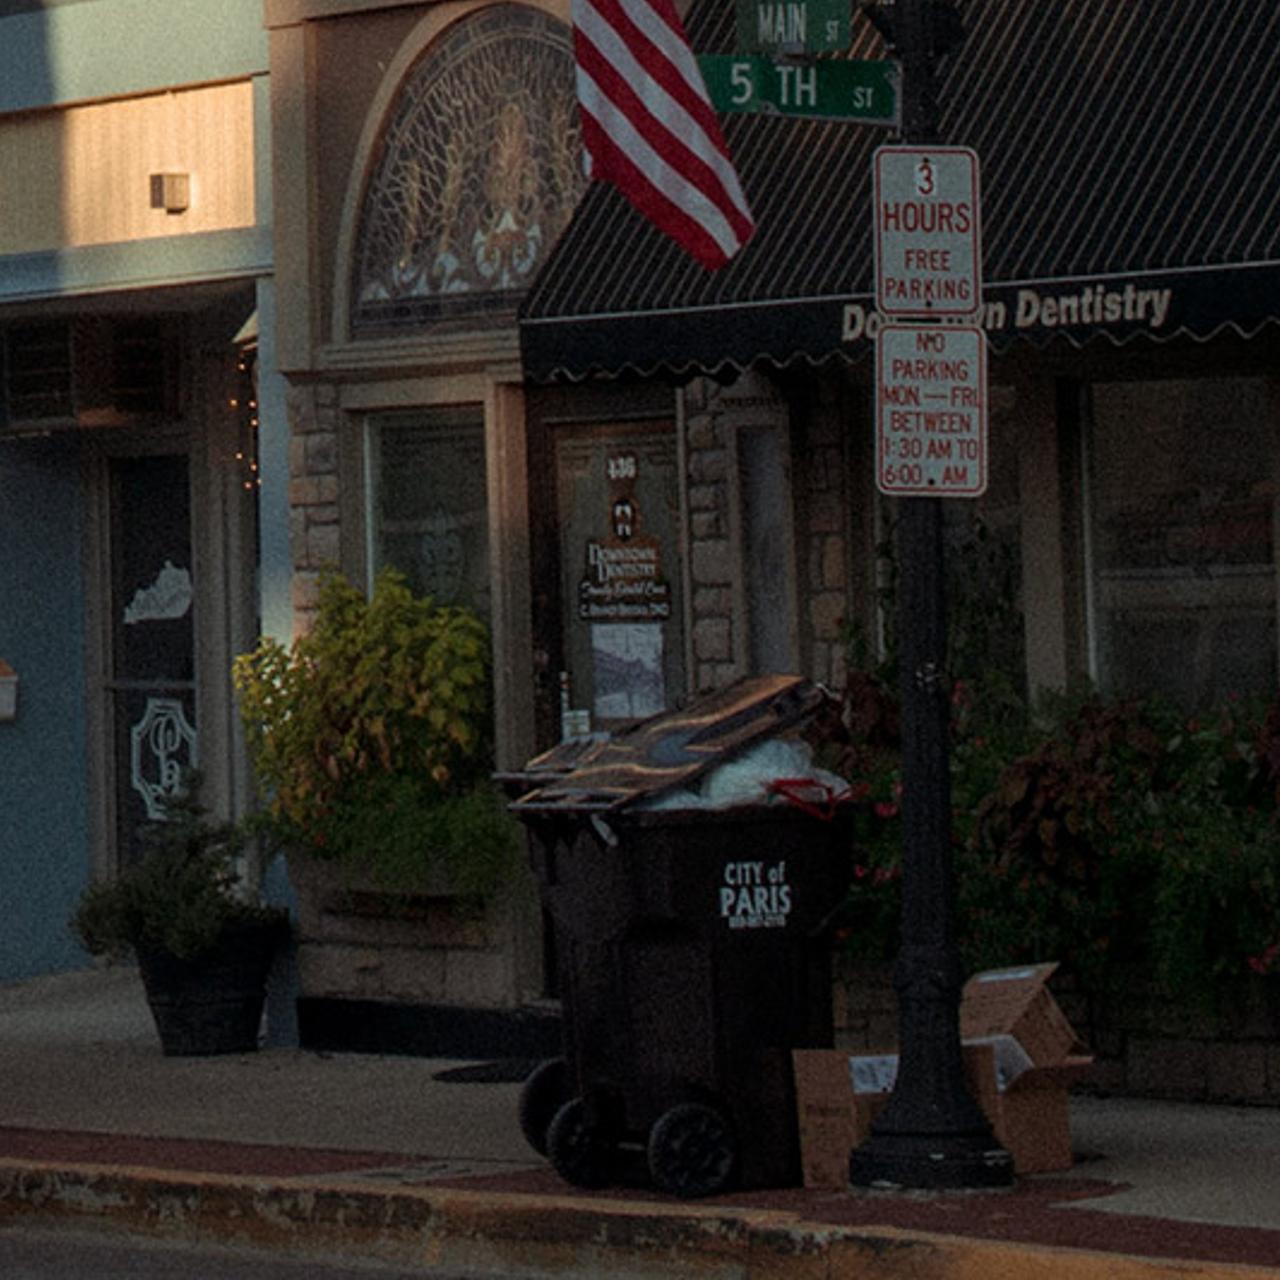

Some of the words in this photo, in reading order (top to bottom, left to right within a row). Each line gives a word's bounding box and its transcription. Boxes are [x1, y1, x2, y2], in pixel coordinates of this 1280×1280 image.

[757, 2, 807, 42] MAIN
[825, 19, 840, 43] ST
[852, 85, 874, 109] ST
[918, 163, 934, 195] 3
[883, 202, 971, 234] HOURS
[904, 249, 952, 272] FREE
[884, 277, 971, 301] PARKING
[1014, 285, 1173, 330] Dentistry
[916, 332, 946, 353] NO
[891, 359, 969, 382] PARKING
[891, 411, 971, 434] BETWEEN
[927, 438, 952, 460] AM
[957, 438, 979, 460] TO
[942, 465, 969, 485] AM
[723, 860, 765, 886] CITY
[767, 859, 787, 884] of
[718, 884, 793, 918] PARIS
